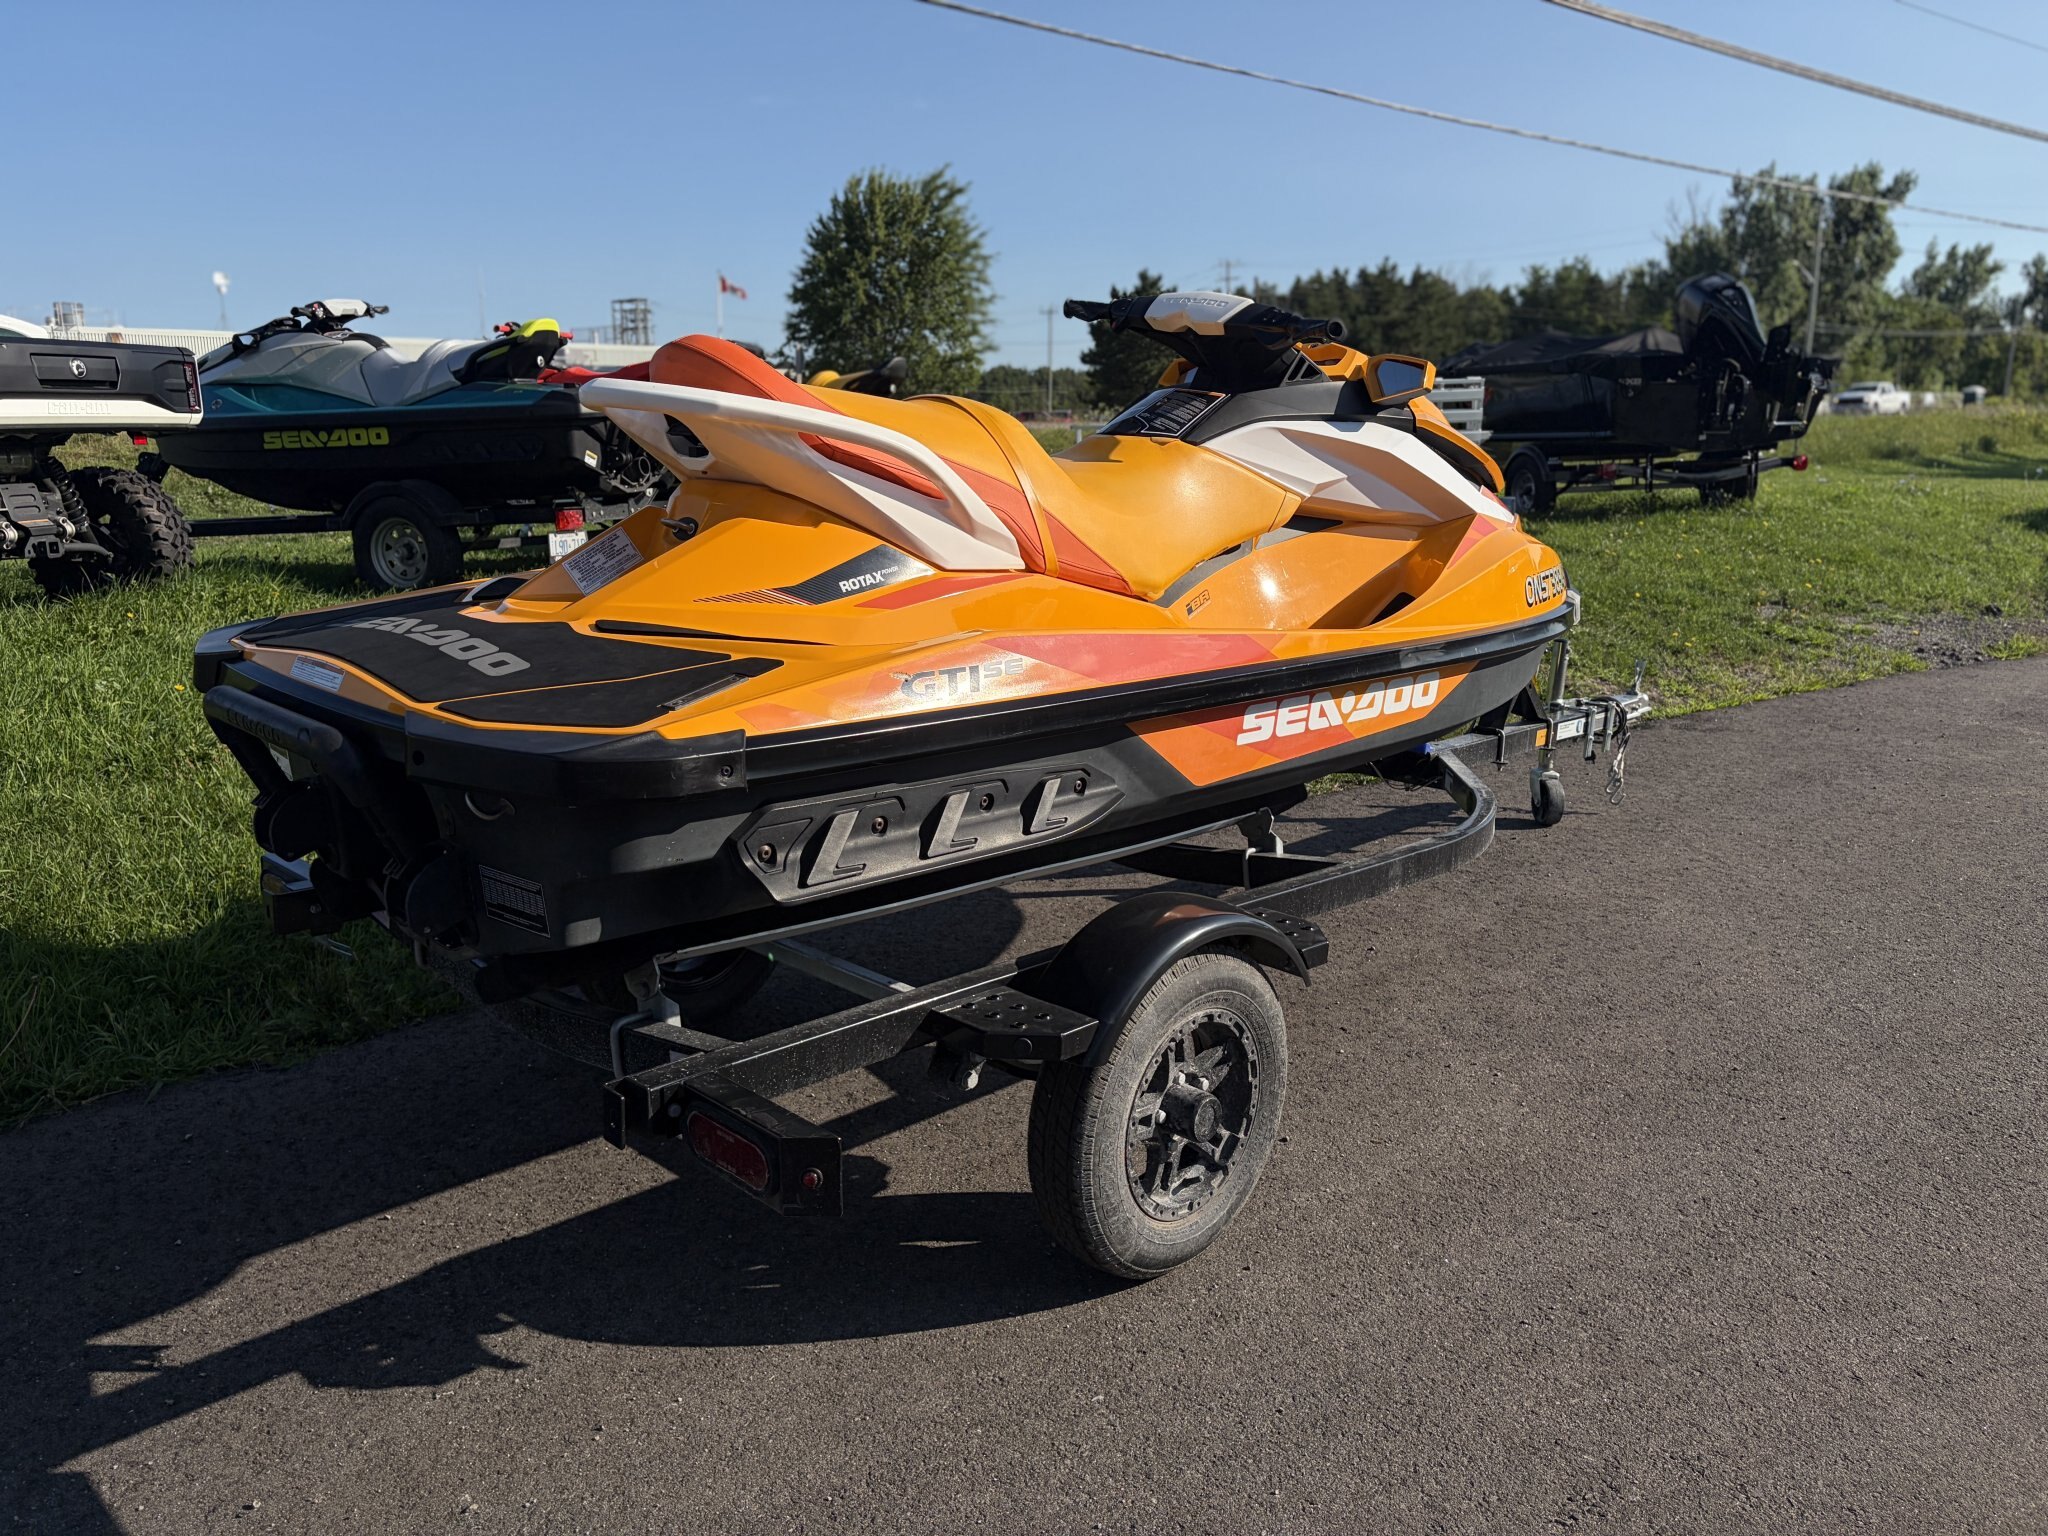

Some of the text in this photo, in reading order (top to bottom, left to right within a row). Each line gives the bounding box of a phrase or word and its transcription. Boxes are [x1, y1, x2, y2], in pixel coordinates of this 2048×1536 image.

[838, 570, 885, 593] ROTAX
[901, 657, 1024, 699] GTI SE
